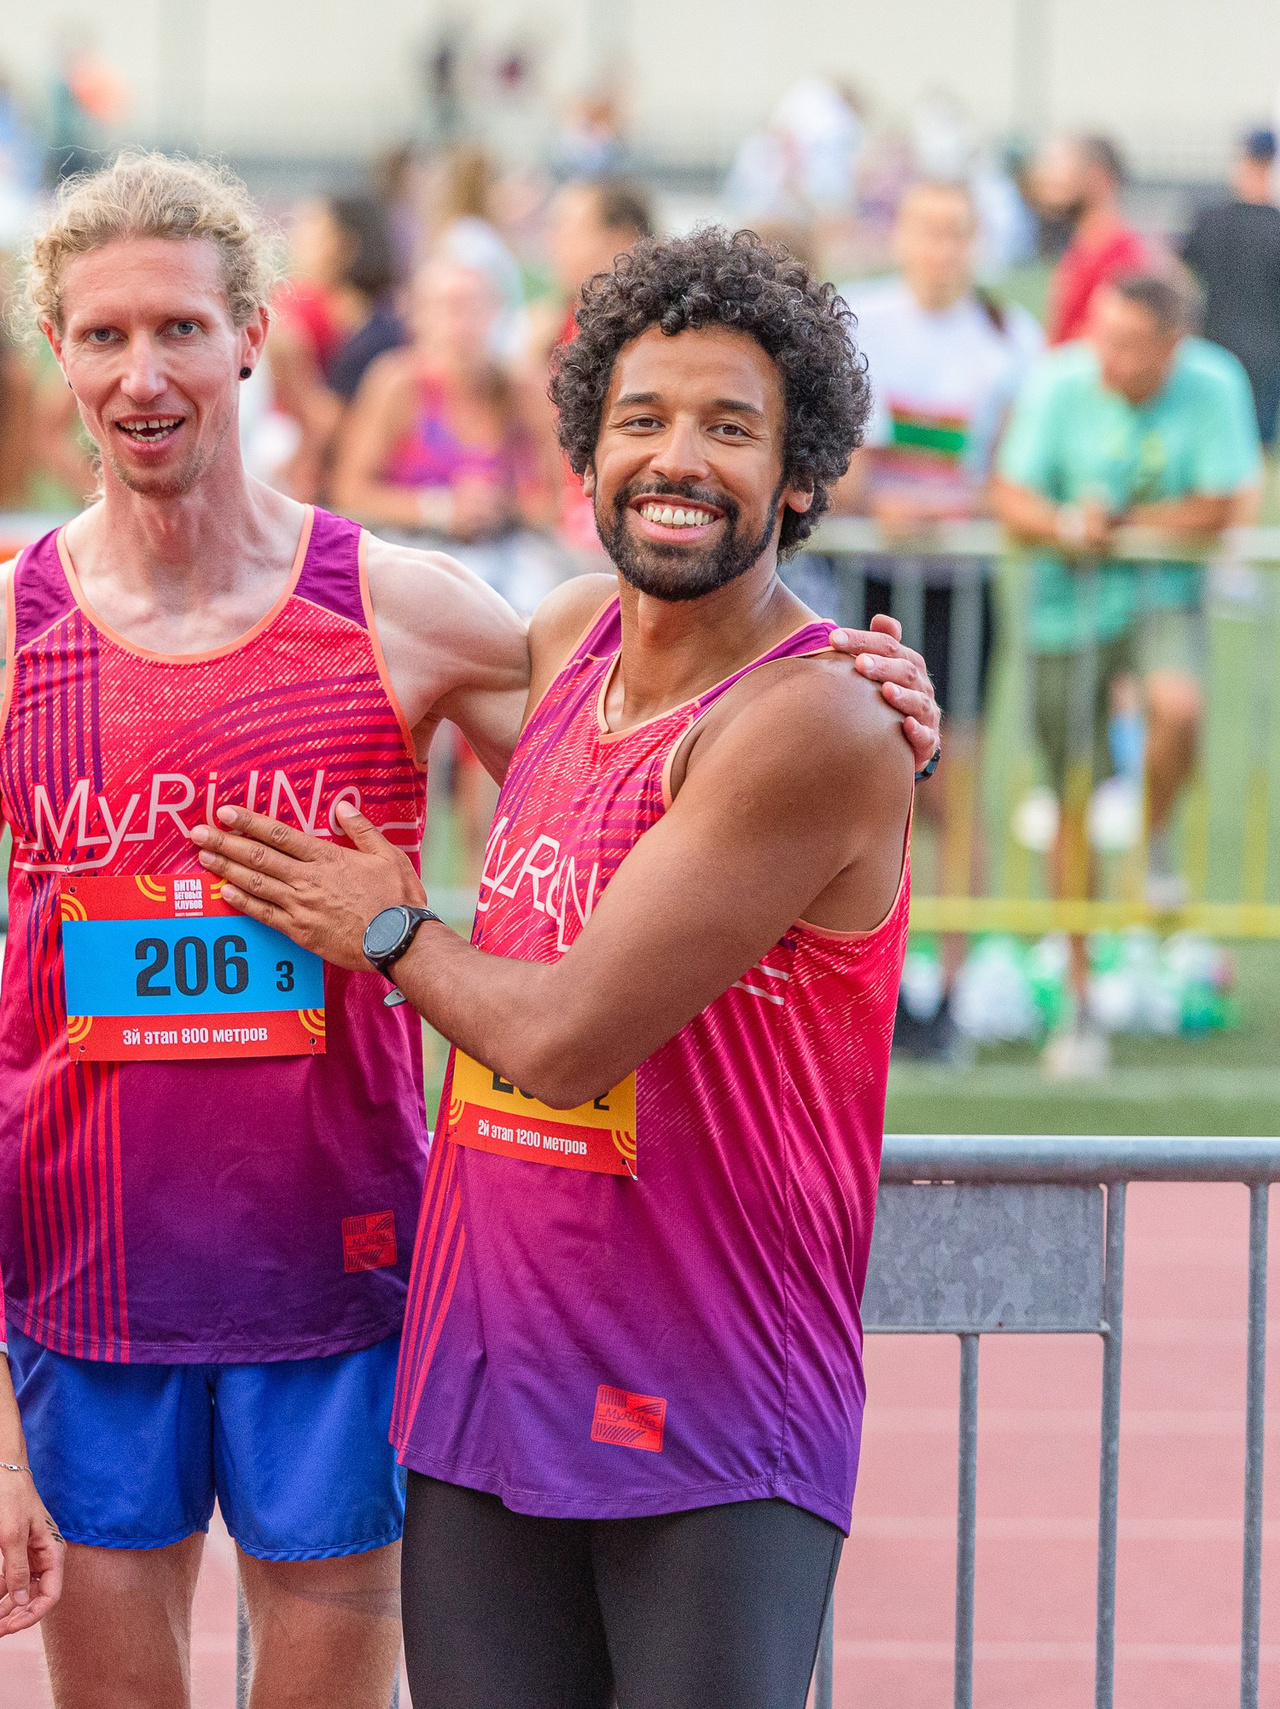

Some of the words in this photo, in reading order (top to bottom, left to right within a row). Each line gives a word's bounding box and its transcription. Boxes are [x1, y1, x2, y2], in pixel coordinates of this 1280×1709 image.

[173, 878, 203, 891] БИТВА
[174, 890, 203, 900] БЕГОВЫХ
[174, 899, 204, 910] КЛУБОВ
[134, 934, 250, 997] 206
[275, 960, 295, 993] 3
[122, 1028, 141, 1046] 3й
[144, 1029, 179, 1045] этап
[181, 1027, 209, 1044] 800
[212, 1027, 269, 1044] метров
[477, 1119, 490, 1137] 2й
[491, 1125, 514, 1143] этап
[515, 1129, 541, 1148] 1200
[542, 1135, 588, 1156] метров
